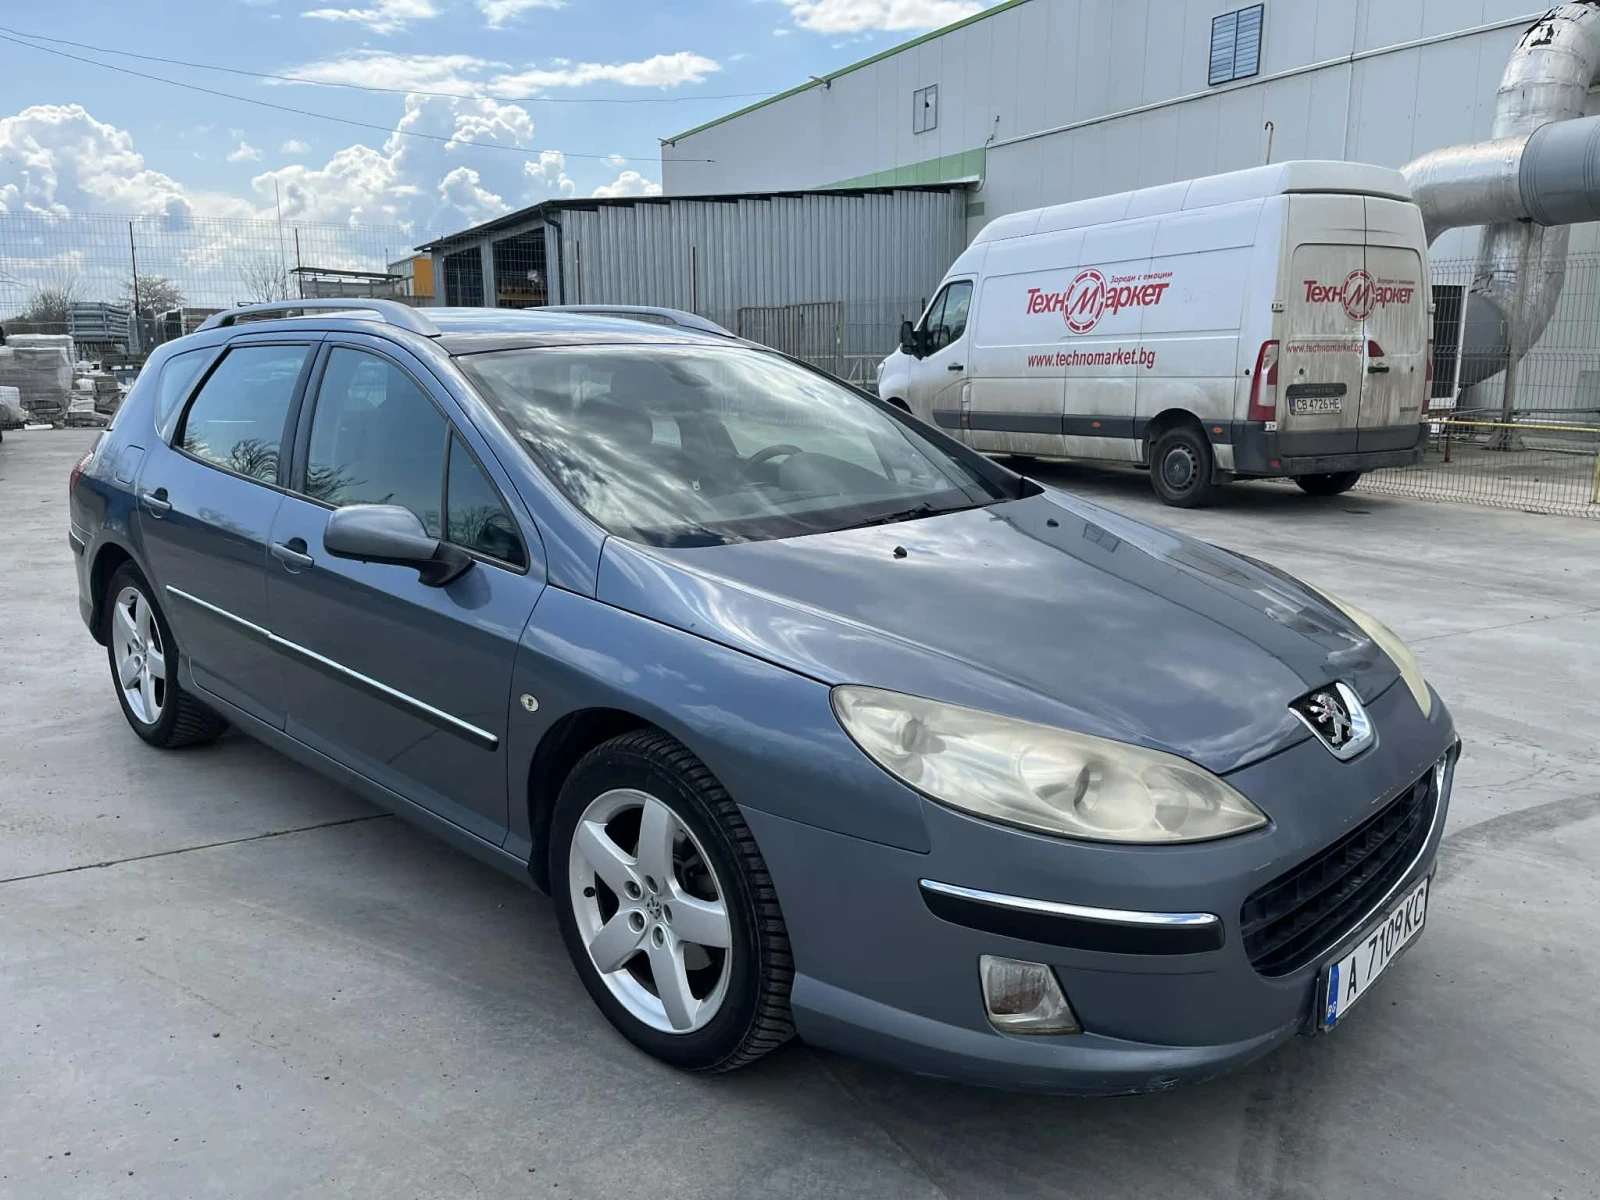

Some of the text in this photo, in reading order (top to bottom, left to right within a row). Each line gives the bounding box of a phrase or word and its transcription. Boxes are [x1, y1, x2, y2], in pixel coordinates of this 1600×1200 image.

[1110, 275, 1136, 285] Зареди
[1287, 343, 1363, 355] www.technomarket.bg
[1027, 346, 1156, 369] www.technomarket.bg
[1296, 398, 1340, 410] CB 4726 HE
[1346, 956, 1357, 1001] A
